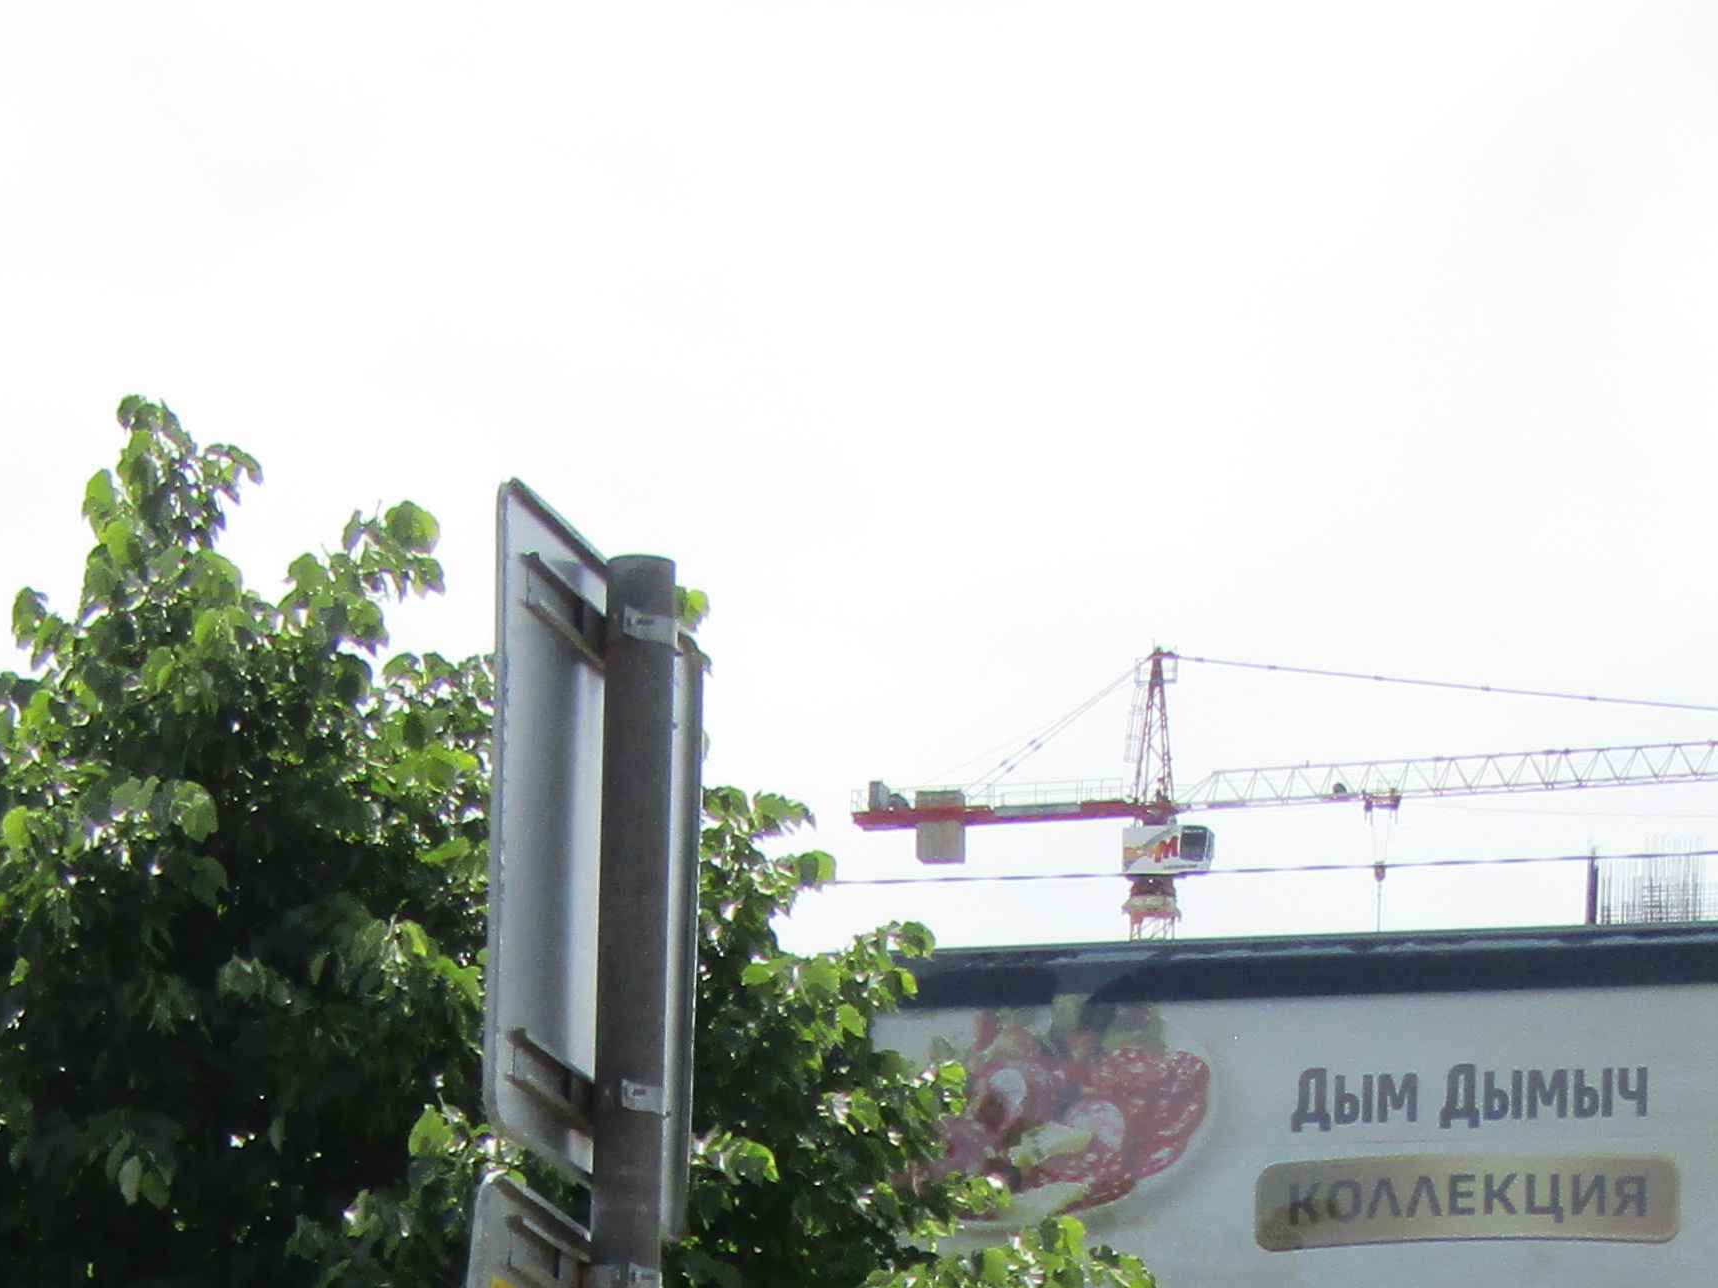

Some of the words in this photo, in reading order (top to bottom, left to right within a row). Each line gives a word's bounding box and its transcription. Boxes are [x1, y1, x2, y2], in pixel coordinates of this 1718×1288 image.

[1291, 1068, 1418, 1132] Дым
[1439, 1064, 1648, 1128] Дымыч
[1289, 1173, 1647, 1223] КОЛЛЕКЦИЯ
